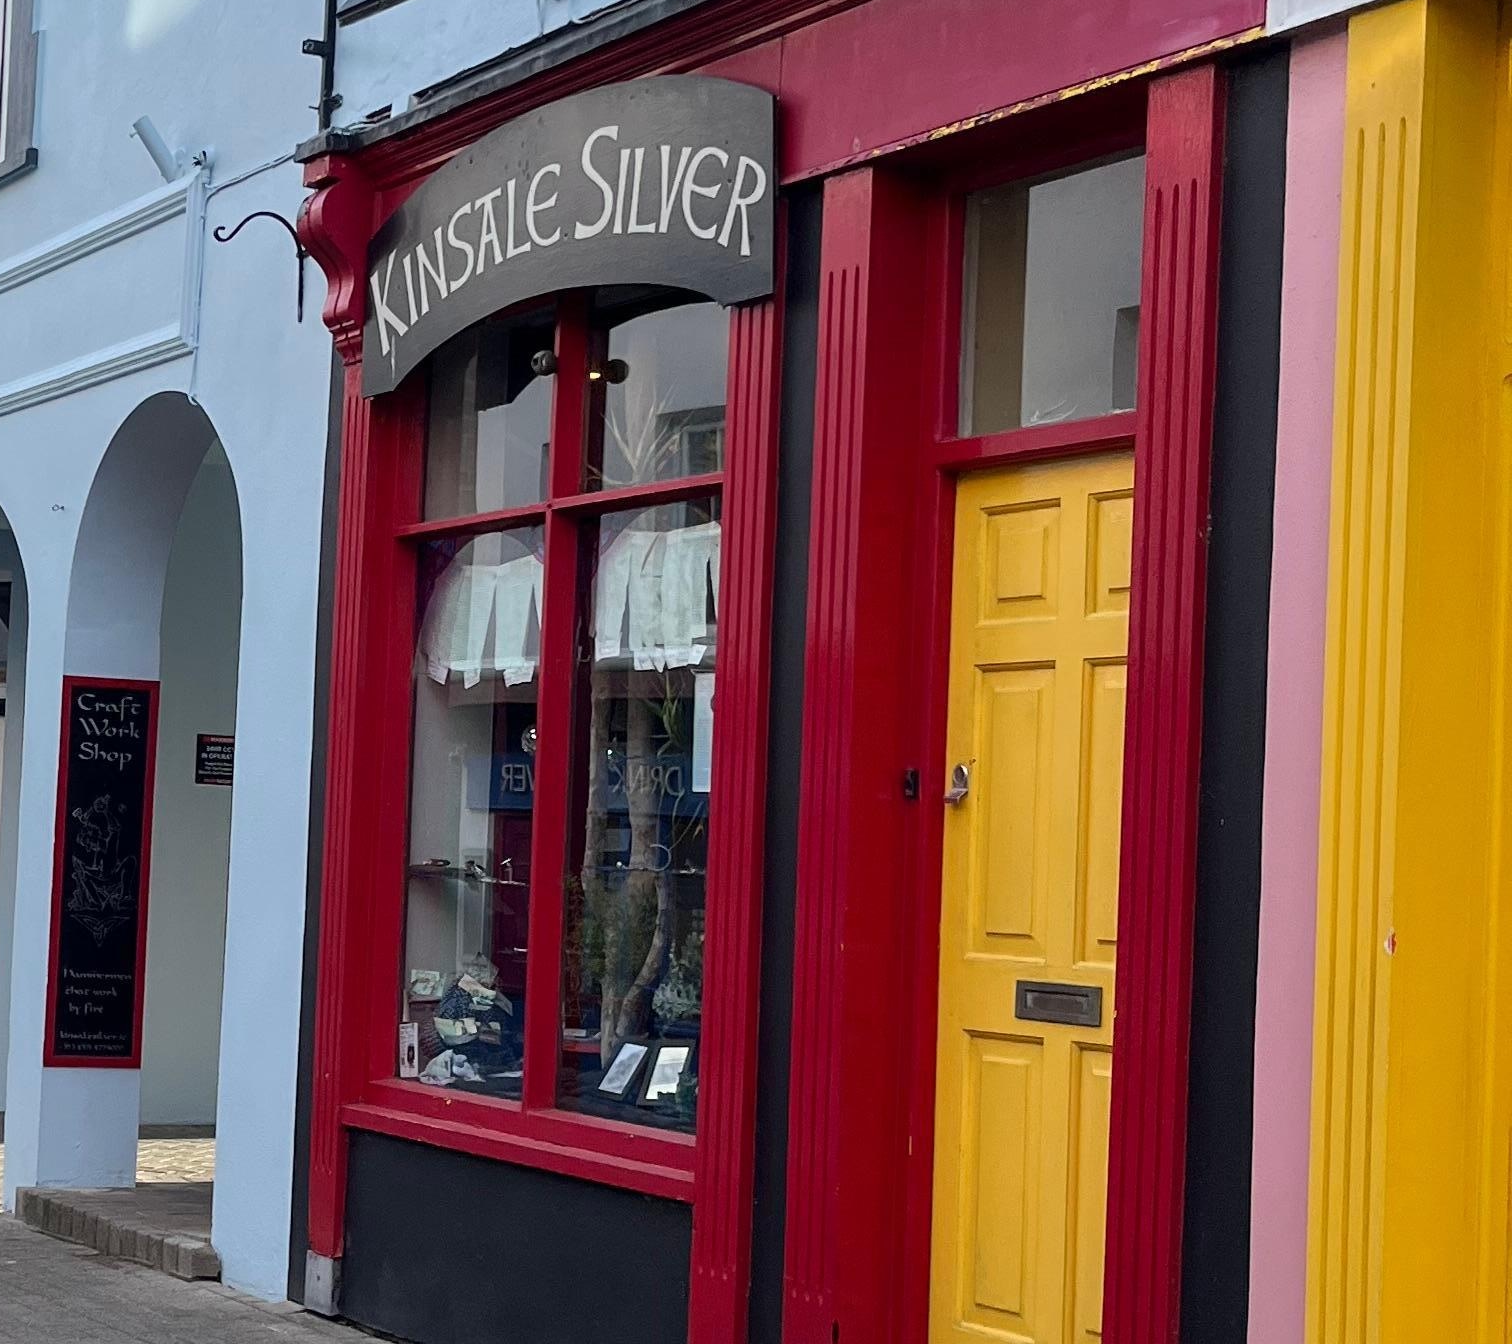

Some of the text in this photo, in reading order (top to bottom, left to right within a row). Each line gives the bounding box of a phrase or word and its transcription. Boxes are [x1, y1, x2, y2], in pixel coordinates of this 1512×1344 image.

[368, 124, 767, 357] KINSALE SILVER
[77, 693, 142, 722] Craft
[79, 717, 140, 739] Work
[77, 741, 133, 772] Shop
